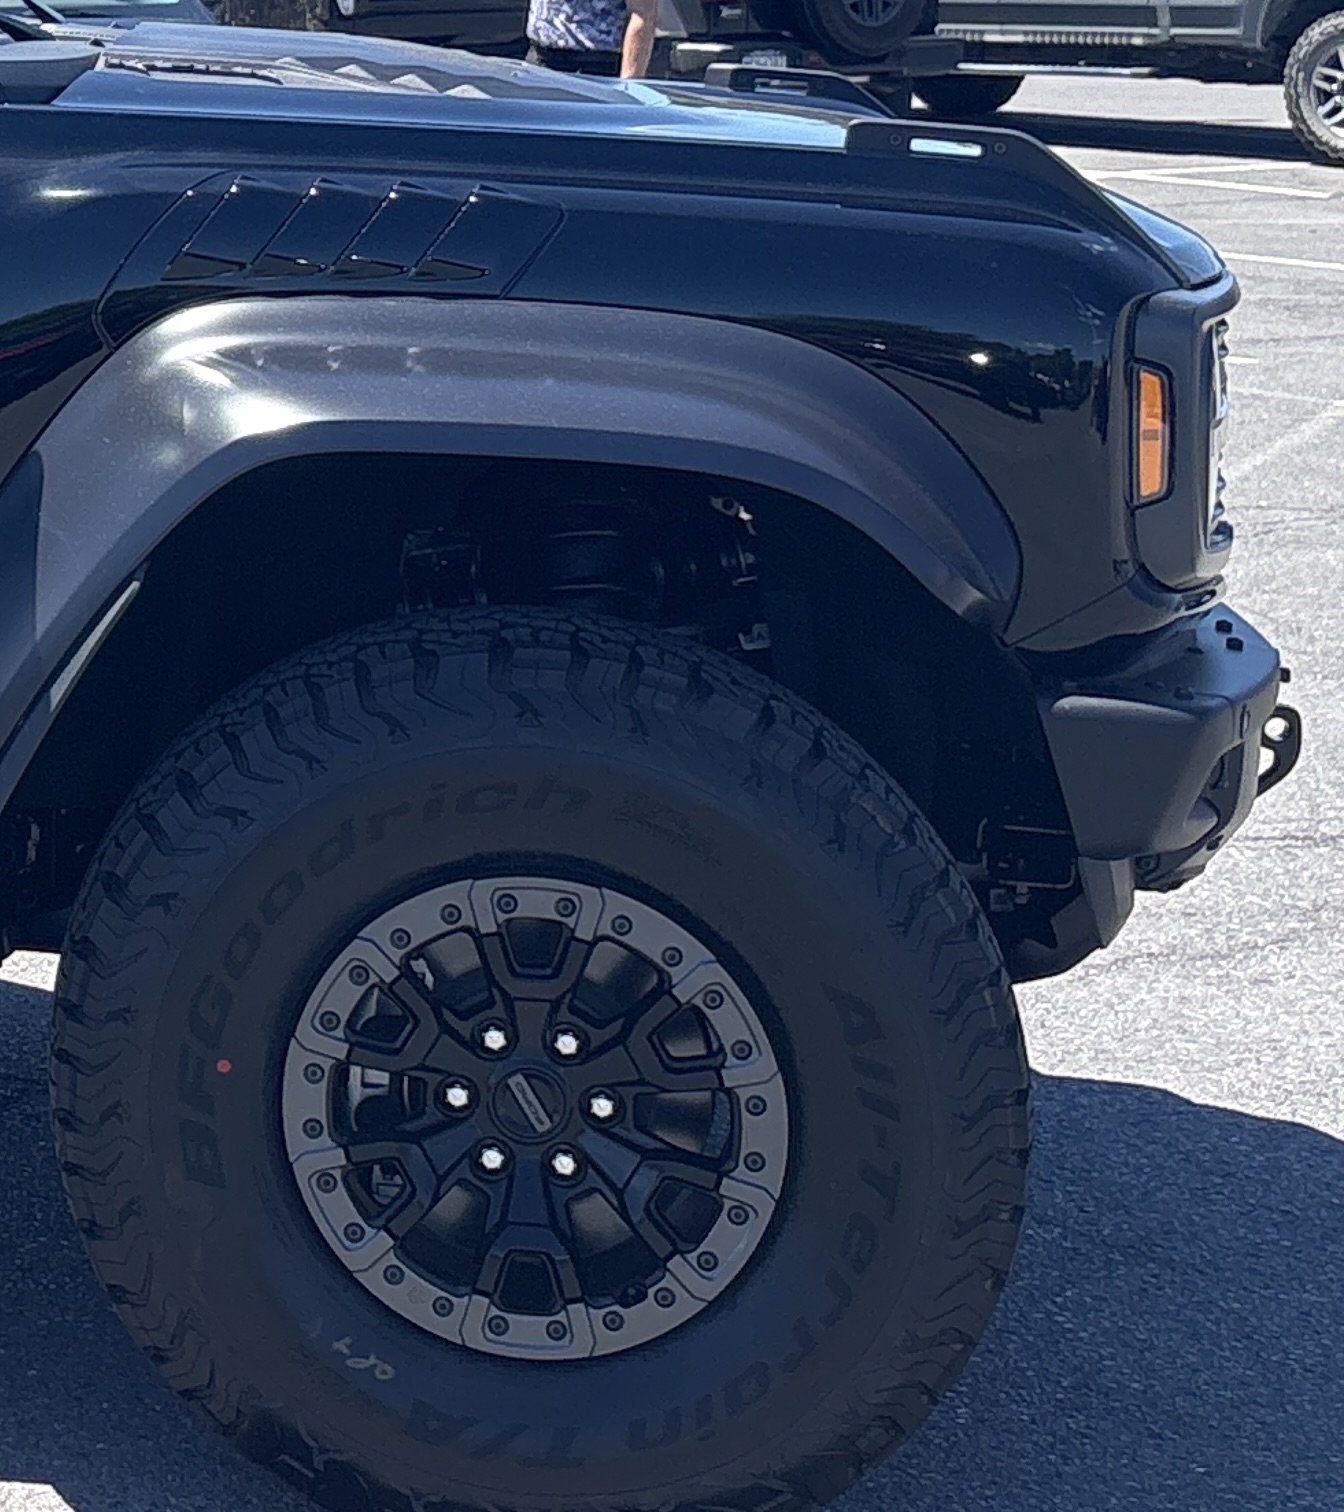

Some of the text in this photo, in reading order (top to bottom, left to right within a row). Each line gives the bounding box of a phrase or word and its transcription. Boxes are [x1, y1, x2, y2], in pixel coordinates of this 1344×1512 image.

[174, 772, 592, 1187] BFGoodrich
[401, 981, 903, 1469] All-Terrain T/A
